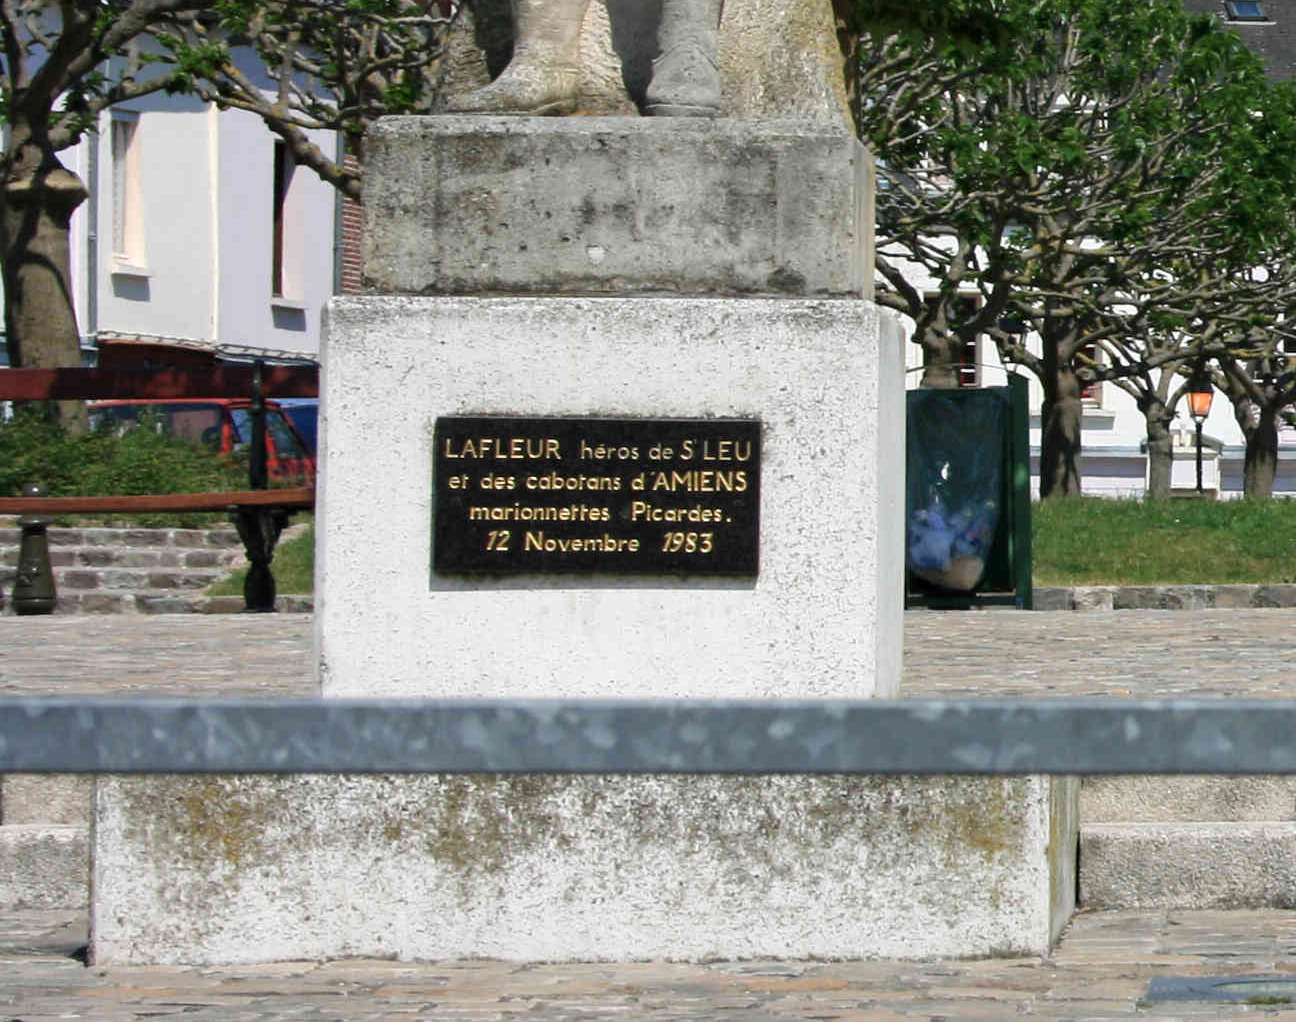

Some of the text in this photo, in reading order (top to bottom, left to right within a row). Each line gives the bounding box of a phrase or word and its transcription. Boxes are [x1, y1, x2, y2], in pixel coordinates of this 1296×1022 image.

[445, 438, 562, 459] LAFLEUR
[580, 440, 640, 460] héros
[648, 442, 674, 460] de
[704, 440, 751, 461] LEU
[448, 474, 470, 490] et
[480, 472, 515, 490] des
[525, 471, 622, 491] cabotans
[469, 501, 732, 523] marionnettes Picardes.
[486, 530, 713, 553] 12 Novembre 1983
